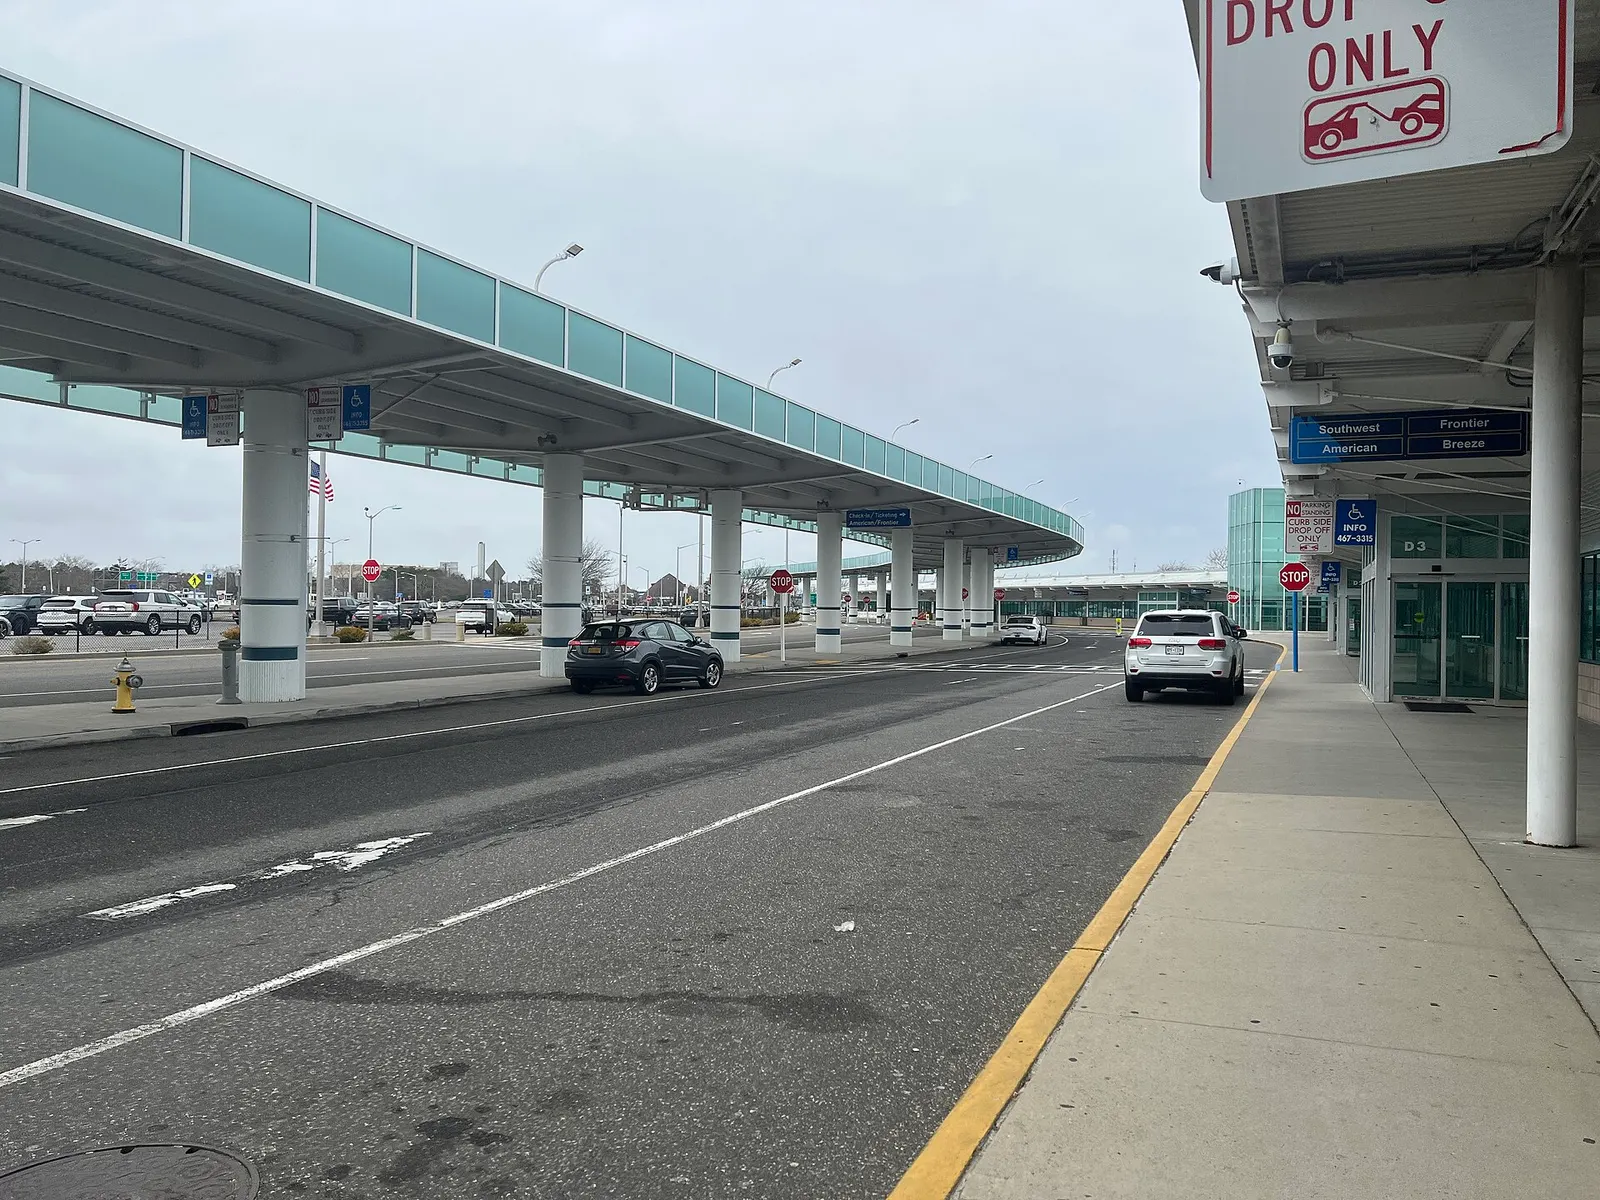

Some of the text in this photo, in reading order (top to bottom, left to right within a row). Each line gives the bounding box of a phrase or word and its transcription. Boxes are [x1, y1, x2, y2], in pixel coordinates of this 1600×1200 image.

[1308, 19, 1444, 92] ONLY
[1319, 423, 1380, 435] Southwest
[1440, 418, 1490, 430] Frontier
[1442, 439, 1485, 449] Breeze
[1322, 444, 1378, 455] American
[1287, 504, 1300, 515] NO
[1288, 518, 1331, 526] CURB SIDE
[1288, 526, 1331, 534] DROP OFF
[1343, 524, 1367, 532] INFO
[1337, 534, 1373, 543] 467-3315
[363, 566, 379, 575] STOP
[1281, 571, 1308, 582] STOP
[771, 577, 791, 587] STOP
